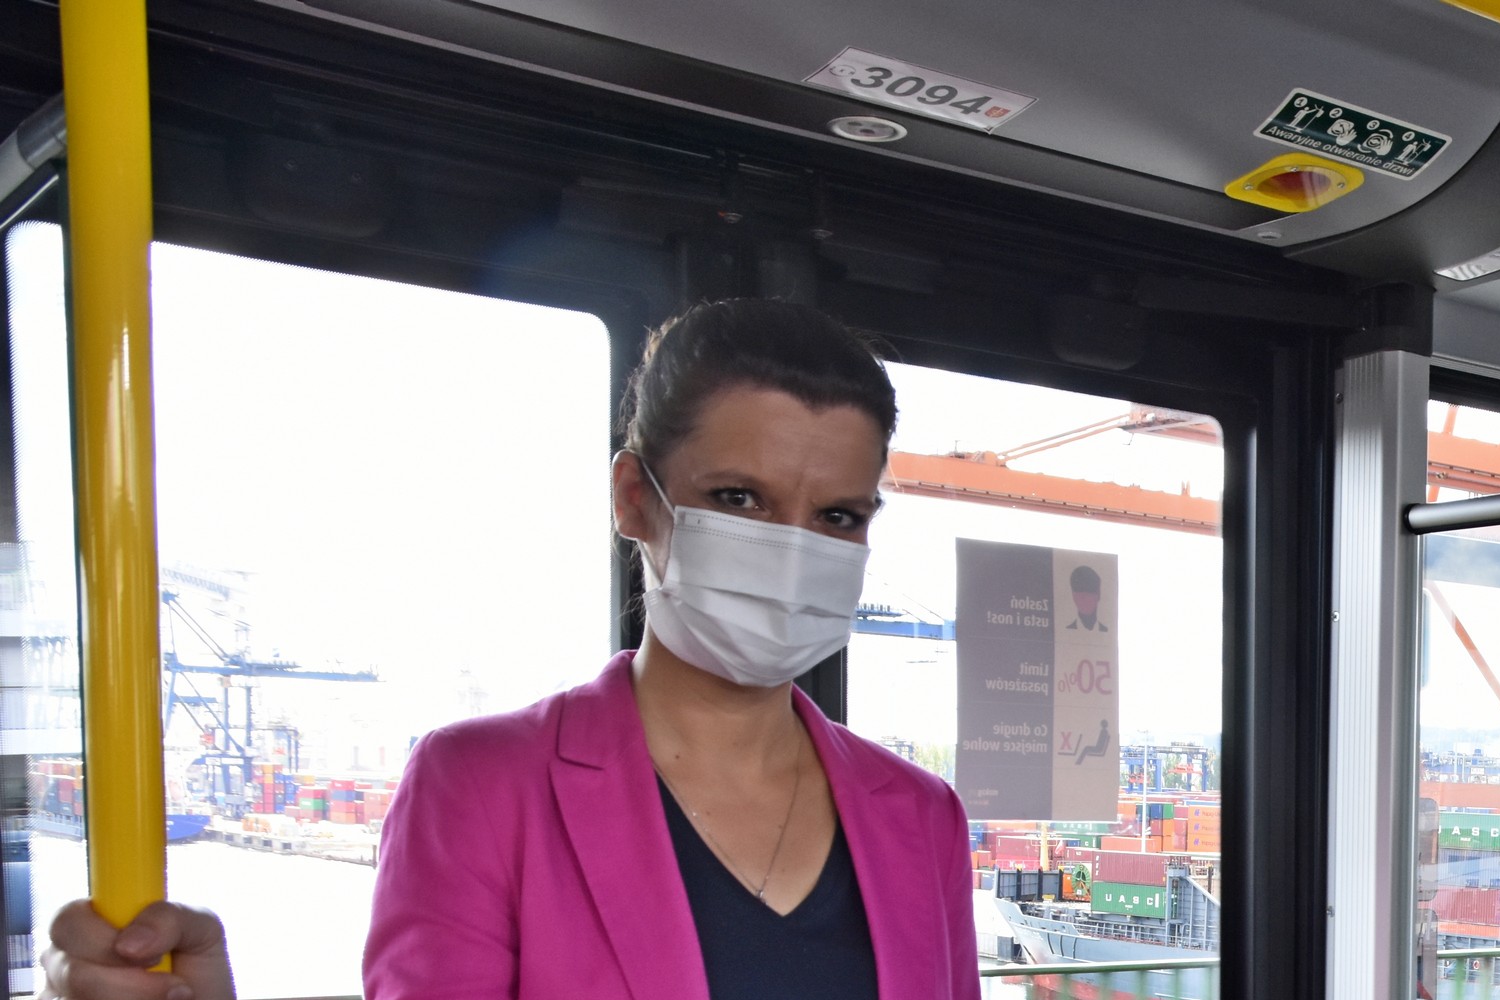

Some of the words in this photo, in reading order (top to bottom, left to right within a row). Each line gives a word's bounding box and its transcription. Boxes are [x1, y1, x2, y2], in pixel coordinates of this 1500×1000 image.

[850, 66, 993, 115] 3094
[1266, 125, 1320, 149] Awaryjne
[1322, 142, 1382, 166] otwieranie
[1382, 160, 1415, 176] drzwi
[1438, 826, 1500, 838] ASC
